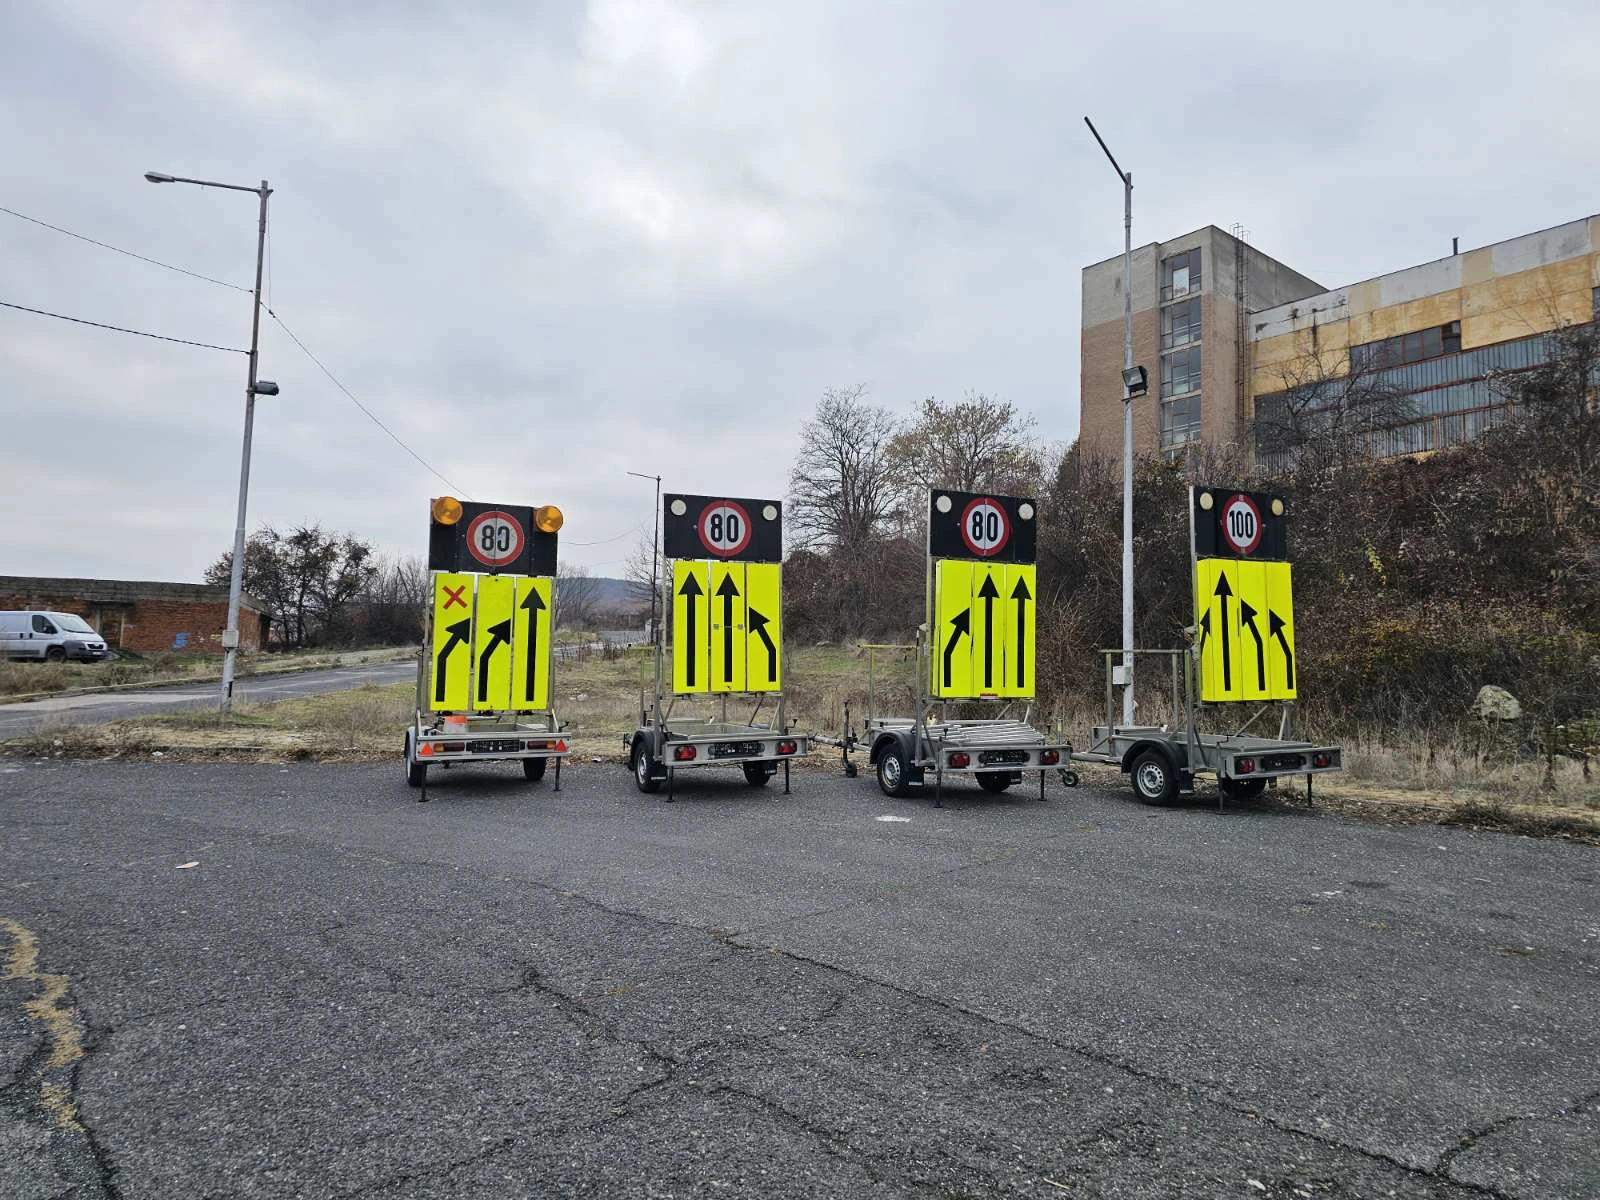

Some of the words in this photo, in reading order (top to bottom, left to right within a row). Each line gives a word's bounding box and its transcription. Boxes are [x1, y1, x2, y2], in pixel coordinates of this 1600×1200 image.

[710, 513, 739, 543] 80
[971, 511, 999, 541] 80
[1229, 510, 1254, 539] 100
